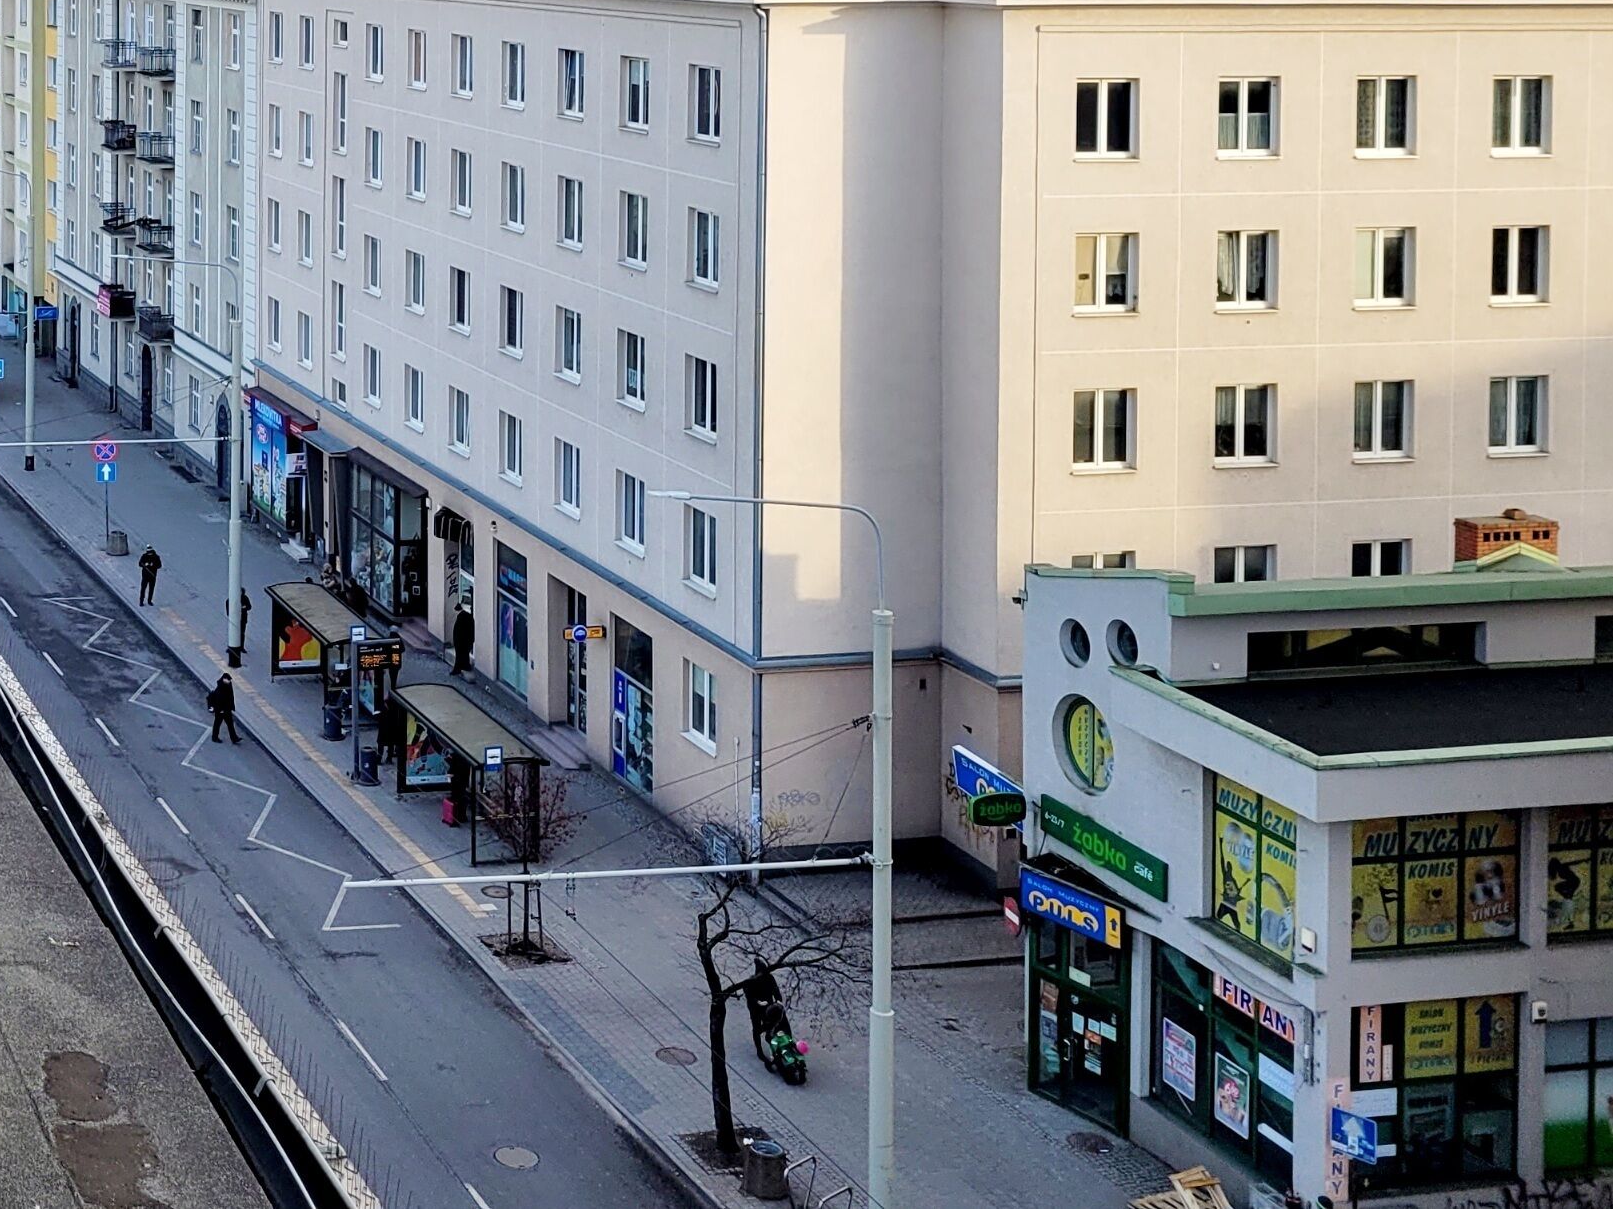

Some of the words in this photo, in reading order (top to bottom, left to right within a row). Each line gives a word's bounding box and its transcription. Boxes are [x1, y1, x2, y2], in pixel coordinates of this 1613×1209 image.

[961, 757, 990, 781] SALON
[1072, 821, 1127, 871] żabka
[1364, 824, 1498, 857] MUZYCZNY
[1133, 862, 1154, 883] café
[1408, 861, 1456, 880] KOMIS
[1471, 901, 1510, 922] VINYLE
[1366, 1006, 1375, 1080] FIRANY
